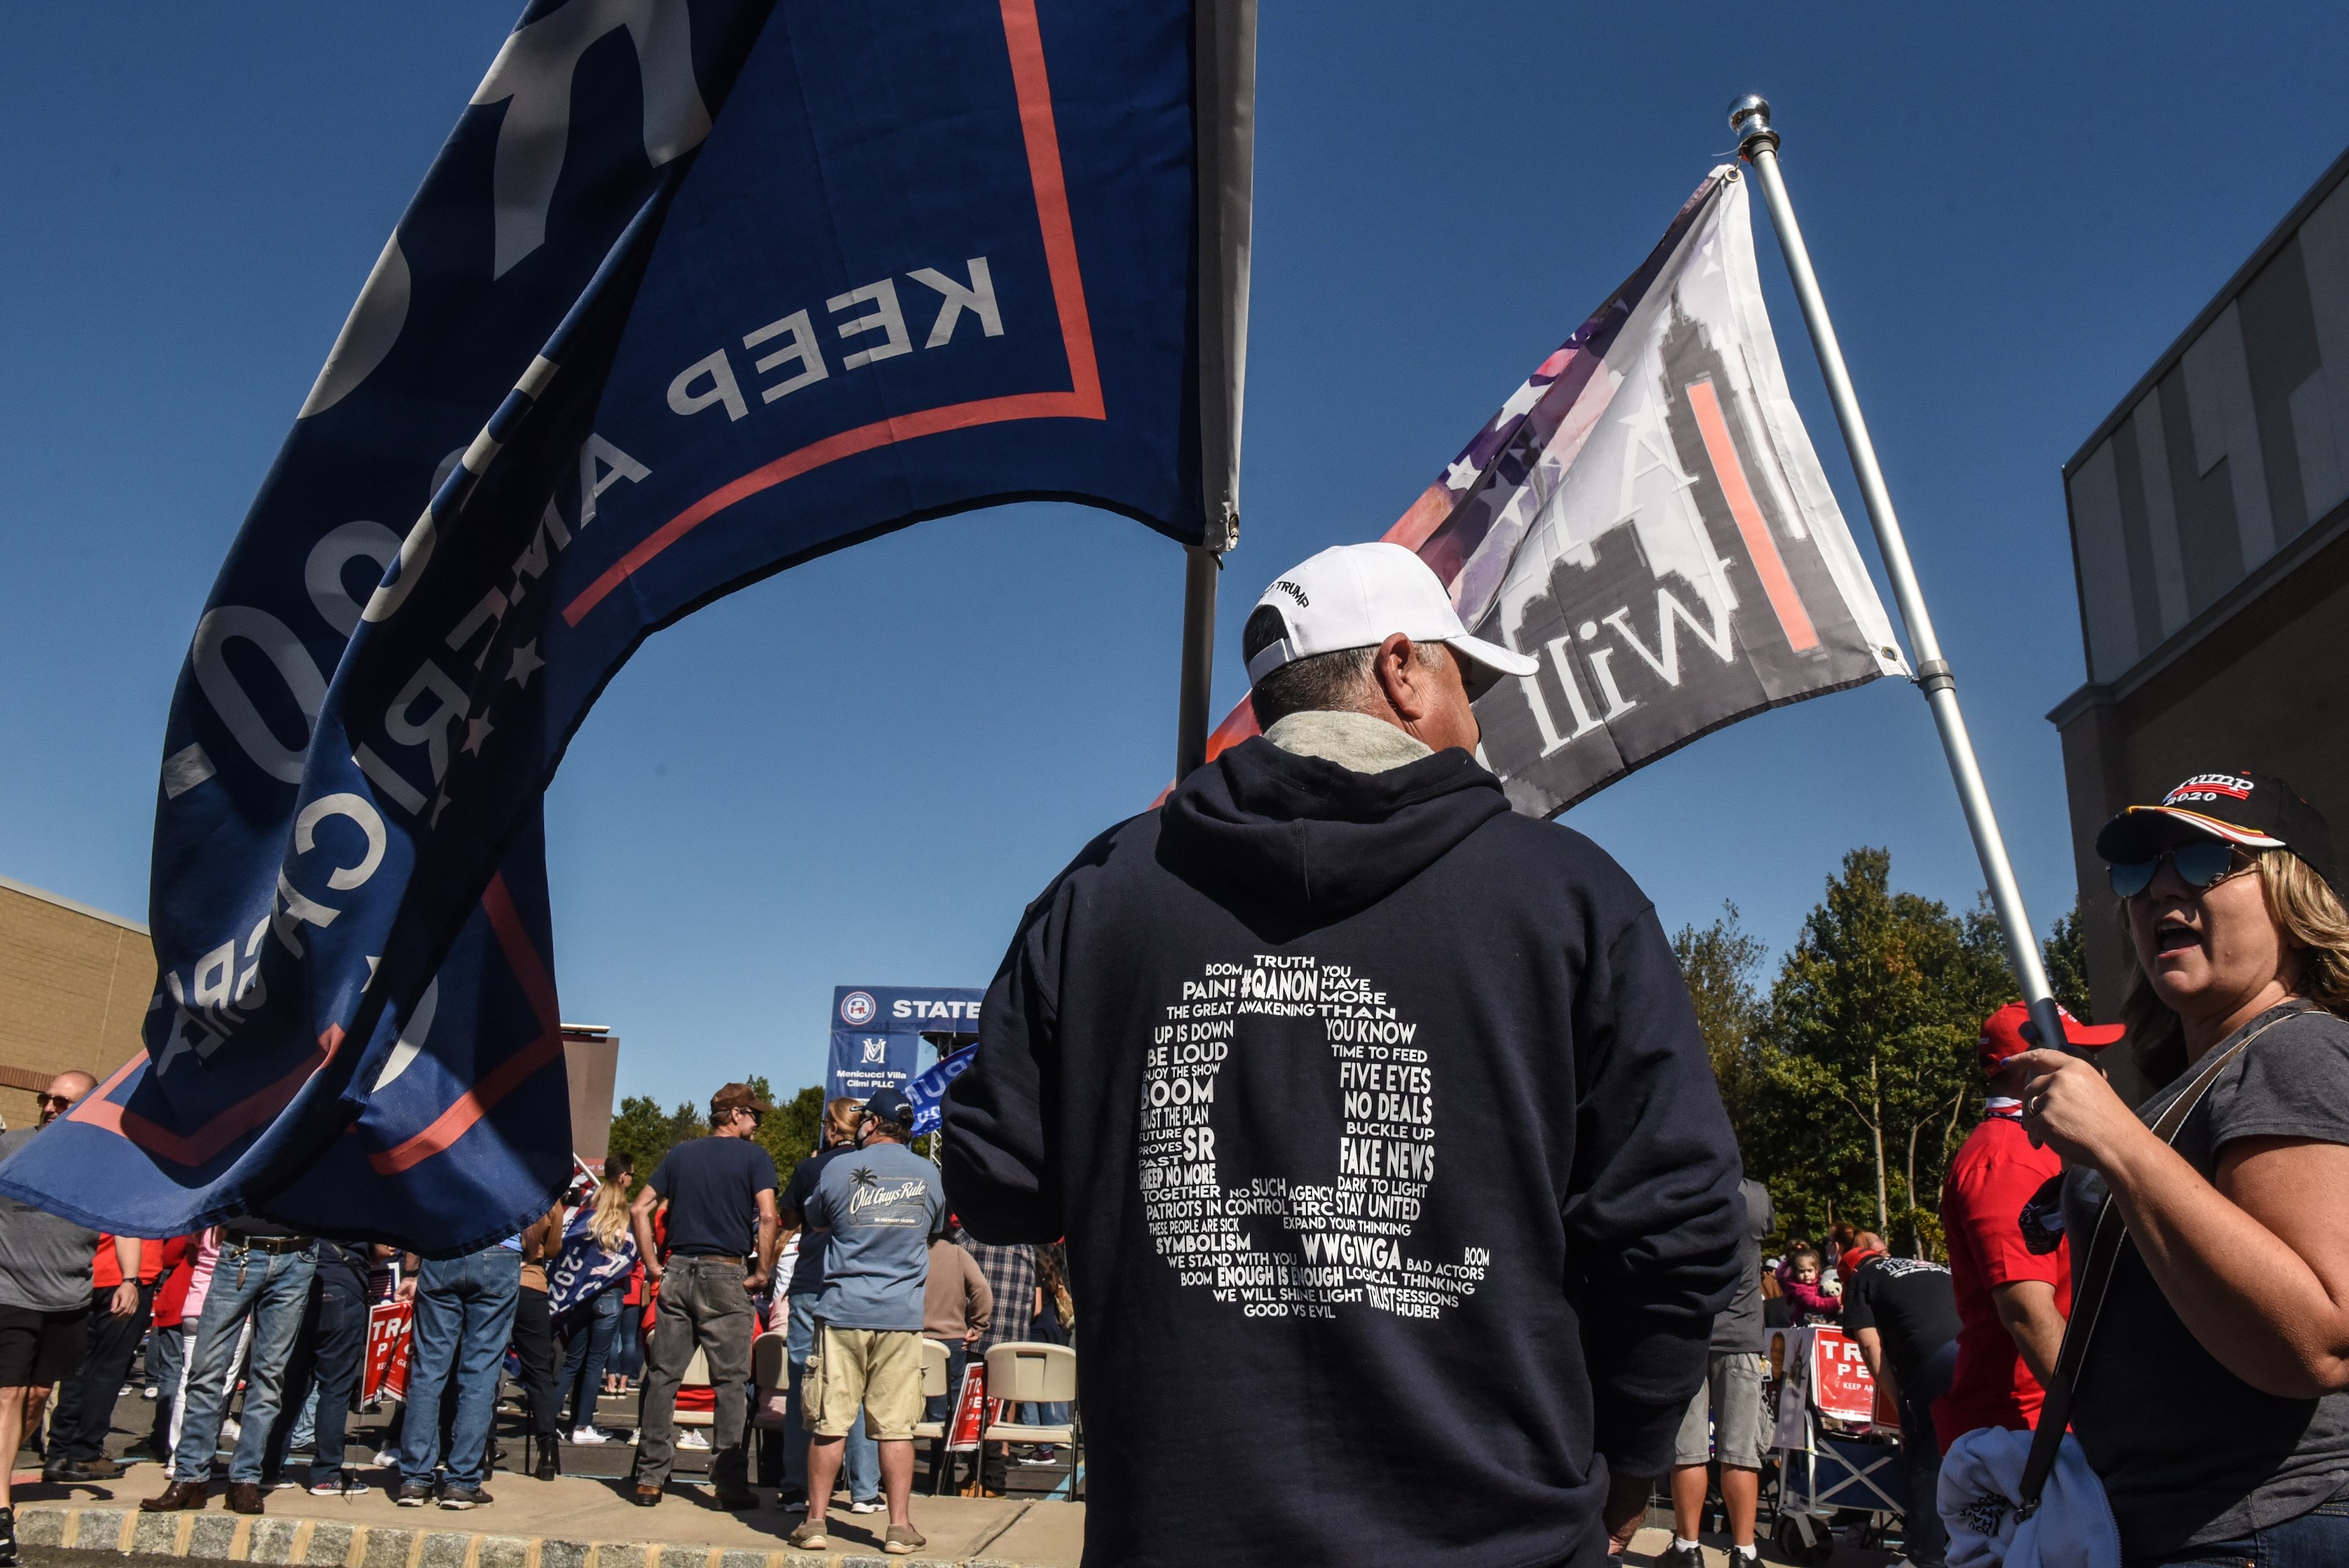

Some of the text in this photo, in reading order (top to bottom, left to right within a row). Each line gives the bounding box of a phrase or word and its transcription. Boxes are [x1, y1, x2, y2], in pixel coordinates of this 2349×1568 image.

[1276, 581, 1310, 609] TRUMP
[2163, 792, 2216, 807] 2020
[1205, 963, 1243, 976] BOOM
[1254, 954, 1315, 968] TRUTH
[1322, 965, 1351, 978] YOU
[1183, 968, 1318, 1001] PAIN! #QANON
[1322, 978, 1370, 991] HAVE
[1320, 990, 1387, 1005] MORE
[893, 1000, 981, 1019] STATE
[1166, 1001, 1315, 1020] THE GREAT AWAKENING
[1317, 1004, 1395, 1020] THAN
[1155, 1020, 1234, 1044] UP IS DOWN
[1325, 1019, 1417, 1045] YOU KNOW
[1147, 1042, 1228, 1067] BE LOUD
[1332, 1044, 1428, 1063] TIME TO FEED
[837, 1070, 907, 1079] Menicucci Villa
[1143, 1062, 1221, 1083] ENJOY THE SHOW
[1340, 1061, 1431, 1095] FIVE EYES
[1141, 1075, 1214, 1111] BOOM
[1140, 1104, 1209, 1130] TRUST THE PLAN
[1344, 1090, 1432, 1125] NO DEALS
[1139, 1128, 1182, 1142] FUTURE
[1346, 1122, 1435, 1141] BUCKLE UP
[1139, 1141, 1183, 1156] PROVES
[1183, 1127, 1216, 1161] SR
[1138, 1155, 1182, 1169] PAST
[1340, 1137, 1434, 1182] FAKE NEWS
[1139, 1163, 1216, 1190] SHEEP NO MORE
[1142, 1185, 1221, 1202] TOGETHER
[1230, 1178, 1334, 1202] NO SUCH AGENCY
[1337, 1175, 1428, 1199] DARK TO LIGHT
[850, 1180, 926, 1215] Old Guys Rule
[1336, 1191, 1420, 1221] STAY UNITED
[1147, 1198, 1289, 1221] PATRIOTS IN CONTROL
[1293, 1202, 1335, 1216] HRC
[1149, 1217, 1240, 1236] THESE PEOPLE ARE SICK
[1283, 1217, 1412, 1237] EXPAND YOUR THINKING
[1156, 1232, 1251, 1255] SYMBOLISM
[1301, 1233, 1401, 1270] WWG1WGA
[1167, 1252, 1297, 1268] WE STAND WITH YOU
[1464, 1246, 1489, 1266] BOOM
[1180, 1266, 1343, 1288] BOOM ENOUGH IS ENOUGH
[1406, 1258, 1484, 1280] BAD ACTORS
[1346, 1266, 1475, 1295] LOGICAL THINKING
[1213, 1288, 1362, 1302] WE WILL SHINE LIGHT
[1366, 1284, 1459, 1312] TRUST SESSIONS
[1244, 1304, 1336, 1319] GOOD VS EVIL
[1397, 1302, 1439, 1319] HUBER
[1820, 1340, 1864, 1362] TR
[1837, 1363, 1870, 1379] PE
[1843, 1382, 1862, 1391] KEEP
